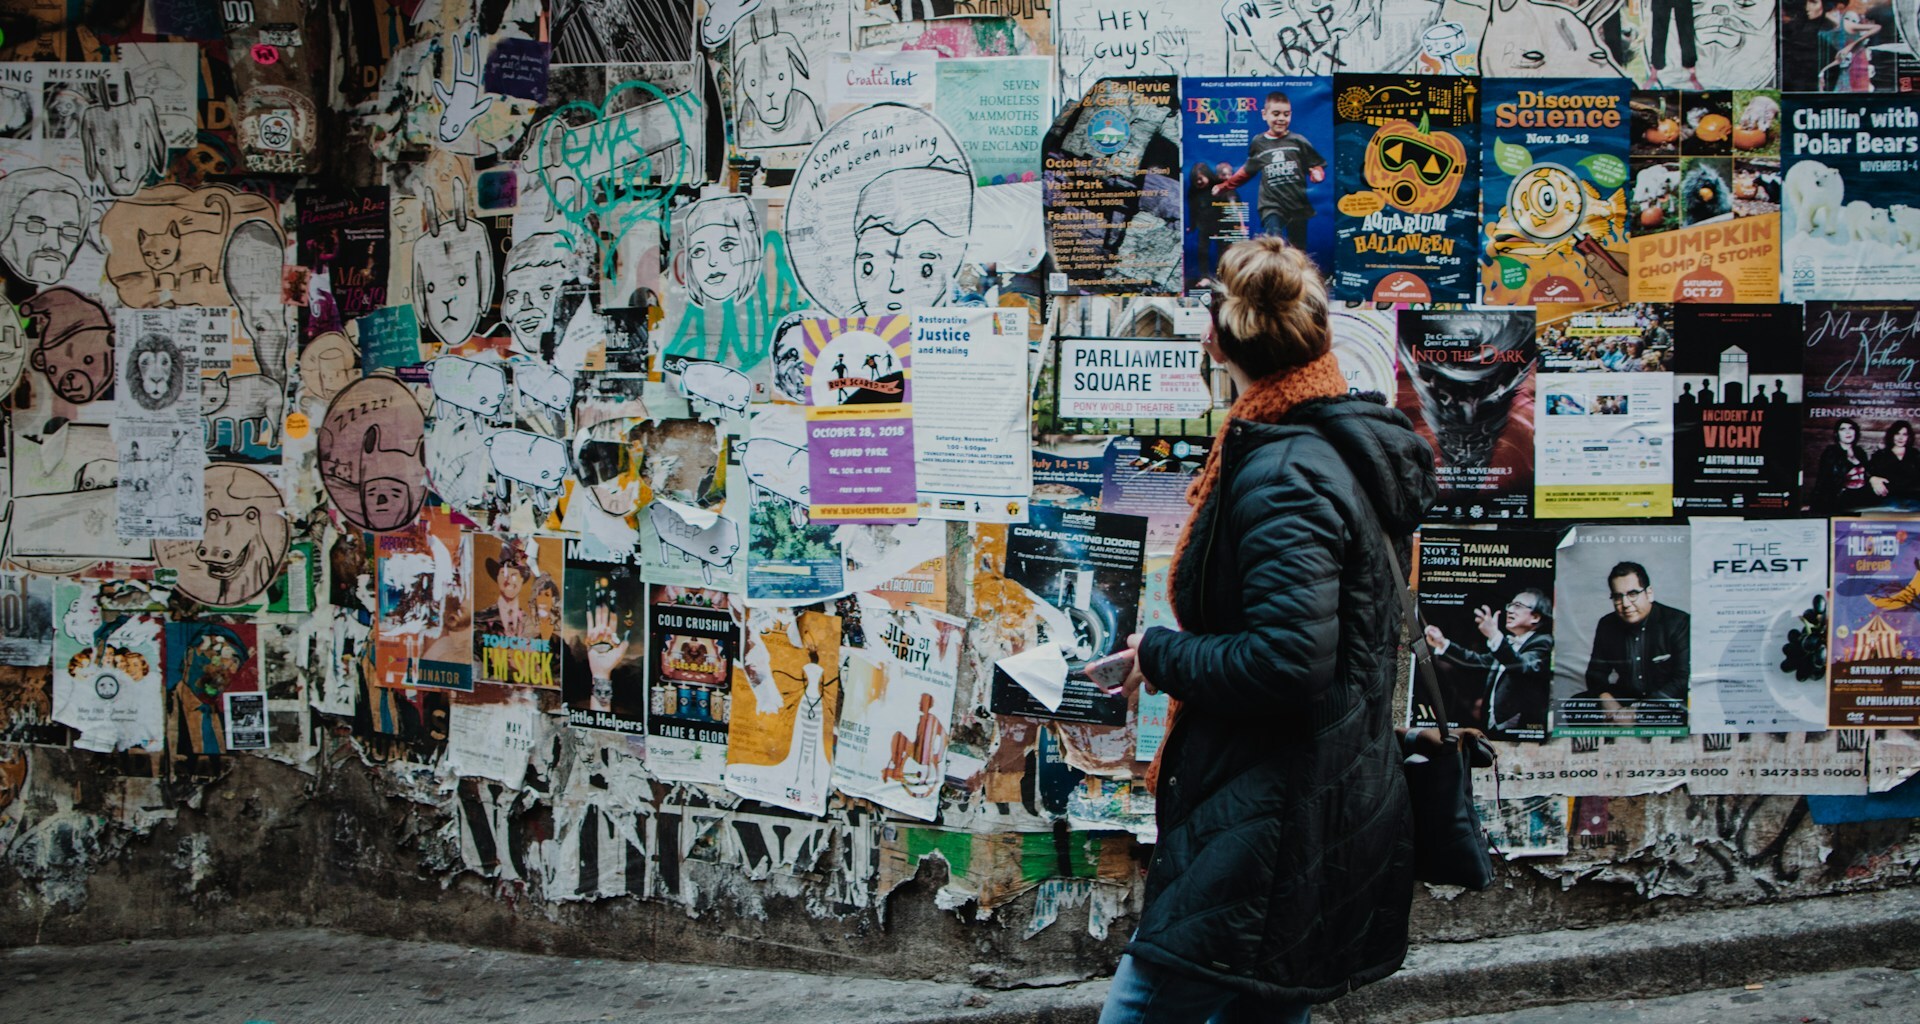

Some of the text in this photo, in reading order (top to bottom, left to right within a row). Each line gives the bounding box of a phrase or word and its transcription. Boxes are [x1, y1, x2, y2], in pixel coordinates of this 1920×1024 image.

[1098, 8, 1149, 31] HEY
[48, 68, 111, 81] MISSING
[1003, 80, 1040, 91] SEVEN
[1111, 80, 1170, 93] Bellevue
[980, 95, 1040, 106] HOMELESS
[1096, 95, 1128, 107] Gem
[1131, 94, 1170, 106] Show
[1187, 97, 1258, 112] DISCOVER
[1517, 90, 1620, 109] Discover
[968, 110, 1040, 121] MAMMOTHS
[1195, 110, 1249, 124] DANCE
[1495, 103, 1621, 128] Science
[1871, 106, 1919, 128] with
[988, 125, 1039, 136] WANDER
[1525, 133, 1554, 144] Nov.
[1793, 131, 1919, 155] Polar Bears
[813, 125, 894, 170] Some rain
[962, 141, 1039, 151] EW ENGLAND
[848, 149, 881, 172] been
[1045, 158, 1093, 169] October
[1096, 157, 1110, 167] 27
[1860, 160, 1902, 172] NOVEMBER
[1046, 179, 1104, 190] Vasa Park
[1047, 211, 1105, 223] Featuring
[1361, 211, 1449, 234] AQUARIUM
[1353, 233, 1456, 256] HALLOWEEN
[1637, 221, 1773, 263] PUMPKIN
[1637, 258, 1696, 279] CHOMP
[1717, 243, 1773, 265] STOMP
[1792, 270, 1816, 279] ZOO
[1682, 280, 1723, 288] SATURDAY
[1682, 287, 1724, 298] OCT 27
[917, 314, 968, 325] Restorative
[917, 326, 971, 342] Justice
[935, 346, 969, 357] Healing
[1074, 349, 1199, 368] PARLIAMENT
[828, 378, 879, 390] RUN SCARED
[1074, 372, 1153, 392] SQUARE
[1073, 402, 1175, 412] PONY WORLD THEATRE
[1702, 410, 1764, 422] INCIDENT AT
[812, 427, 857, 439] OCTOBER
[878, 426, 905, 437] 2018
[1702, 425, 1762, 449] VICHY
[829, 447, 889, 458] SEWARD PARK
[1705, 455, 1765, 466] ARTHUR MILLER
[1466, 467, 1506, 475] NOVEMBER
[1013, 527, 1141, 549] COMMUNICATING DOORS
[1619, 535, 1685, 544] CITY MUSIC
[568, 540, 643, 566] Mer's
[1105, 547, 1140, 556] AYCKBOURN
[1422, 546, 1448, 556] NOV
[1462, 543, 1510, 555] TAIWAN
[1732, 542, 1782, 556] THE
[1421, 556, 1460, 566] 7:30PM
[1461, 556, 1553, 568] PHILHARMONIC
[1712, 558, 1808, 573] FEAST
[657, 614, 683, 628] COLD
[482, 633, 551, 653] TOUCH ME
[513, 651, 554, 687] SICK
[569, 708, 643, 732] ittle Helpers
[505, 721, 523, 734] MAY
[659, 724, 730, 745] FAME & GLORY
[1559, 769, 1599, 779] 6000
[1690, 768, 1729, 777] 6000
[1823, 768, 1862, 777] 6000
